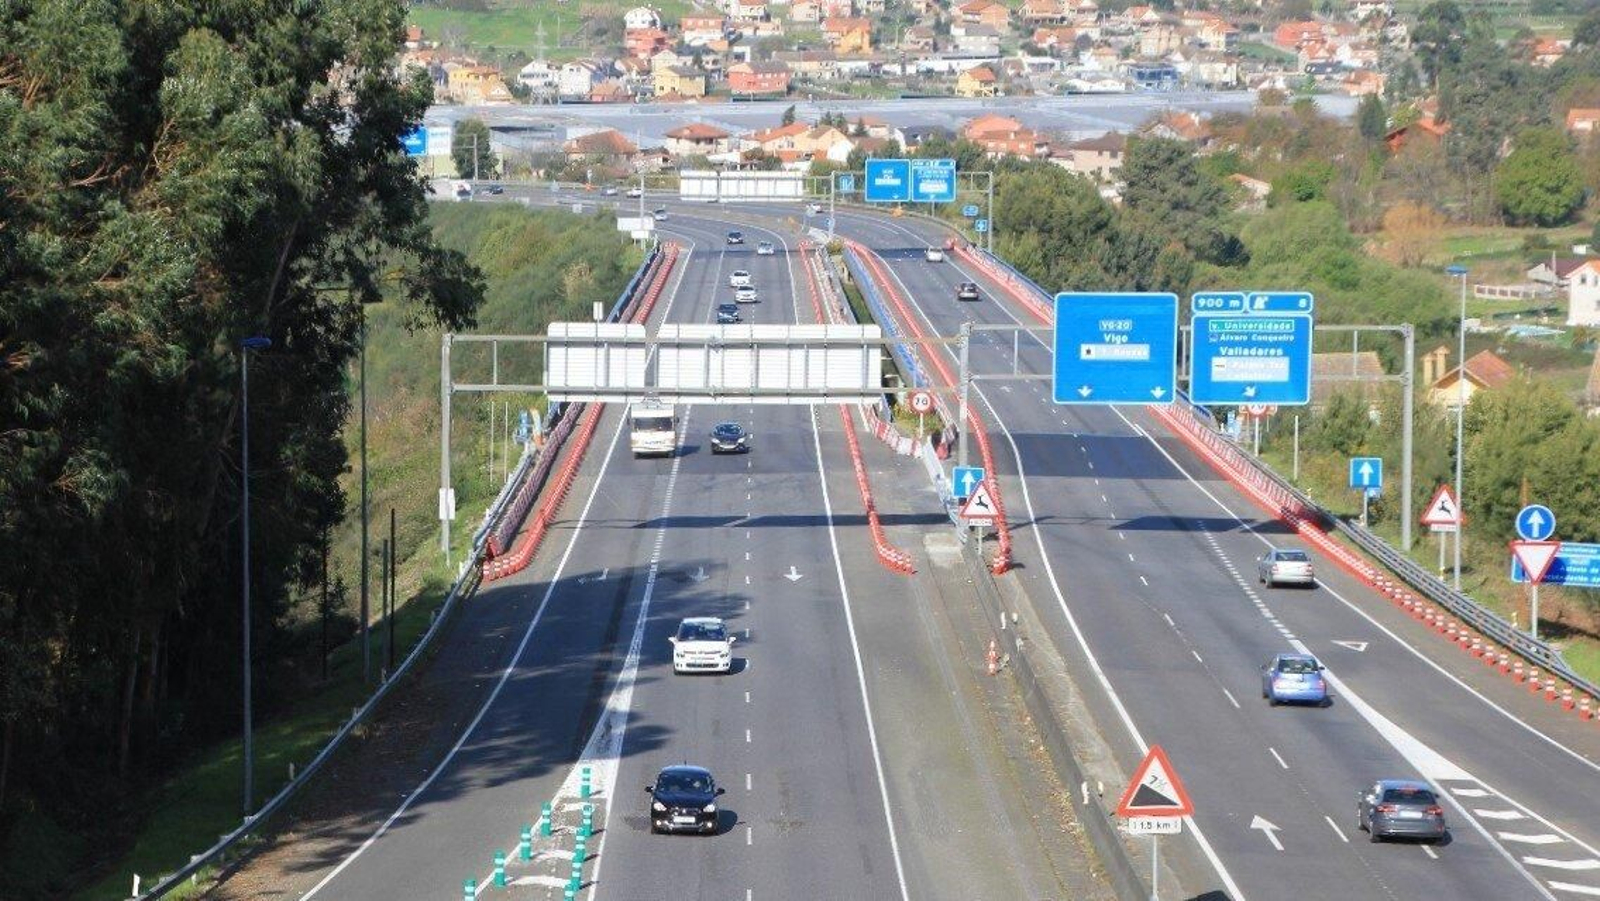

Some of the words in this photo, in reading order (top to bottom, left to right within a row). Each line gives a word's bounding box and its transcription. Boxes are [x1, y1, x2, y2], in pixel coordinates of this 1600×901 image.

[1198, 297, 1223, 307] 900
[1229, 299, 1240, 307] m
[1224, 321, 1291, 330] Universidade
[1104, 333, 1128, 344] Vigo
[1220, 346, 1283, 356] Valladares
[915, 397, 928, 405] 70
[1156, 820, 1171, 830] km
